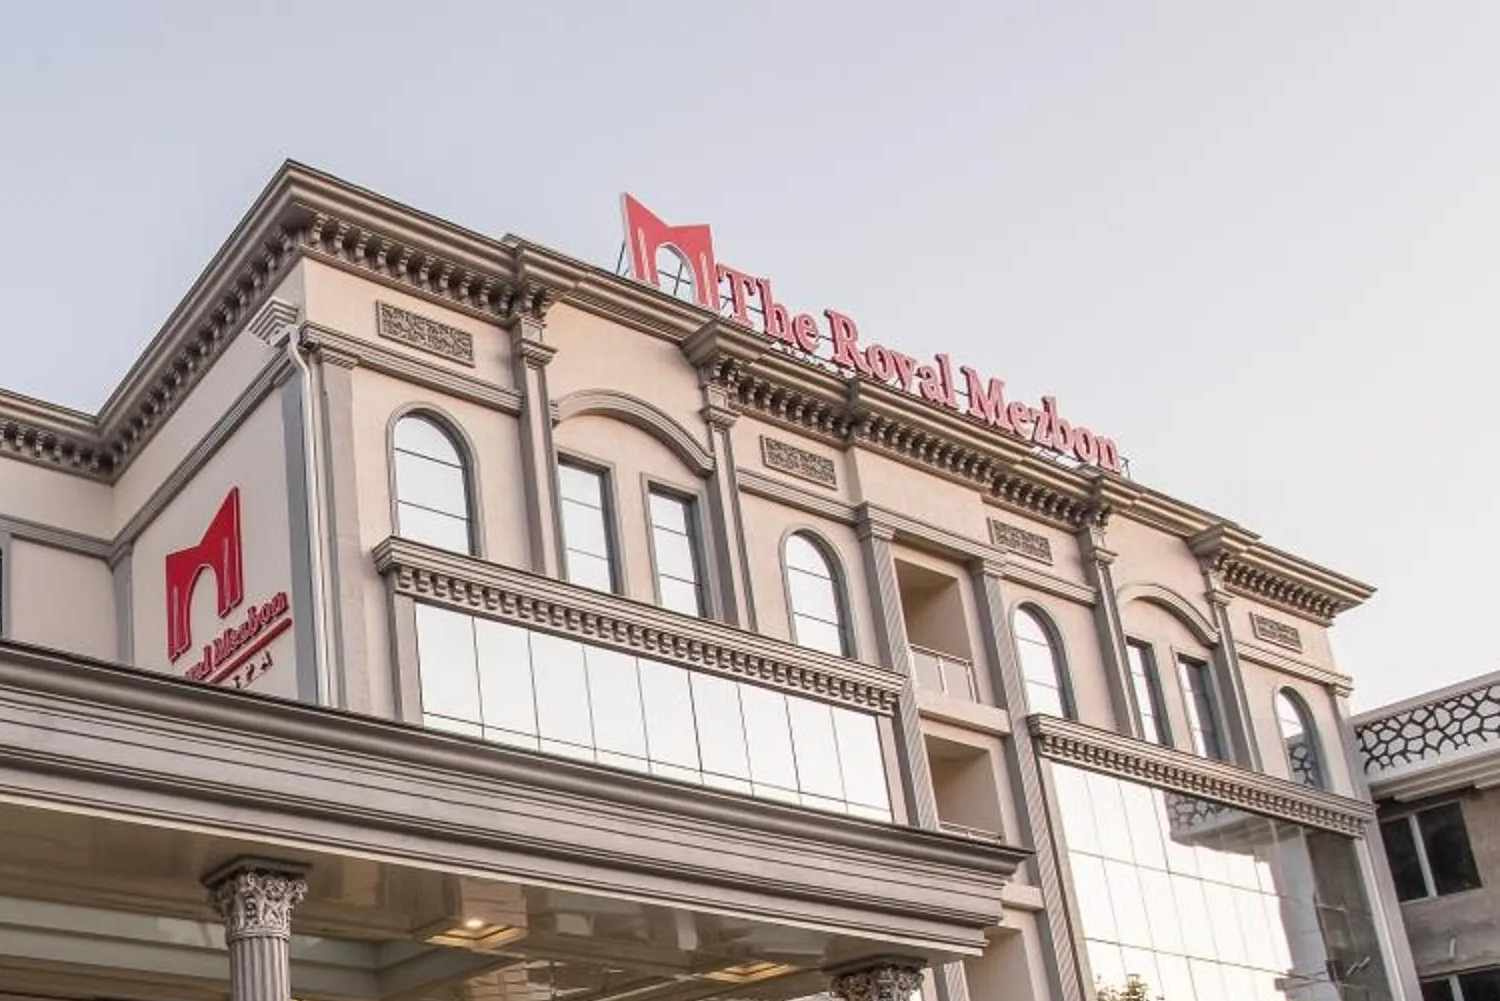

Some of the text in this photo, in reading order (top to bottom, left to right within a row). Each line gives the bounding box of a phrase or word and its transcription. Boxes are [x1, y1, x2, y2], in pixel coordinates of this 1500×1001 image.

[716, 263, 1120, 475] The Royal Mezbon
